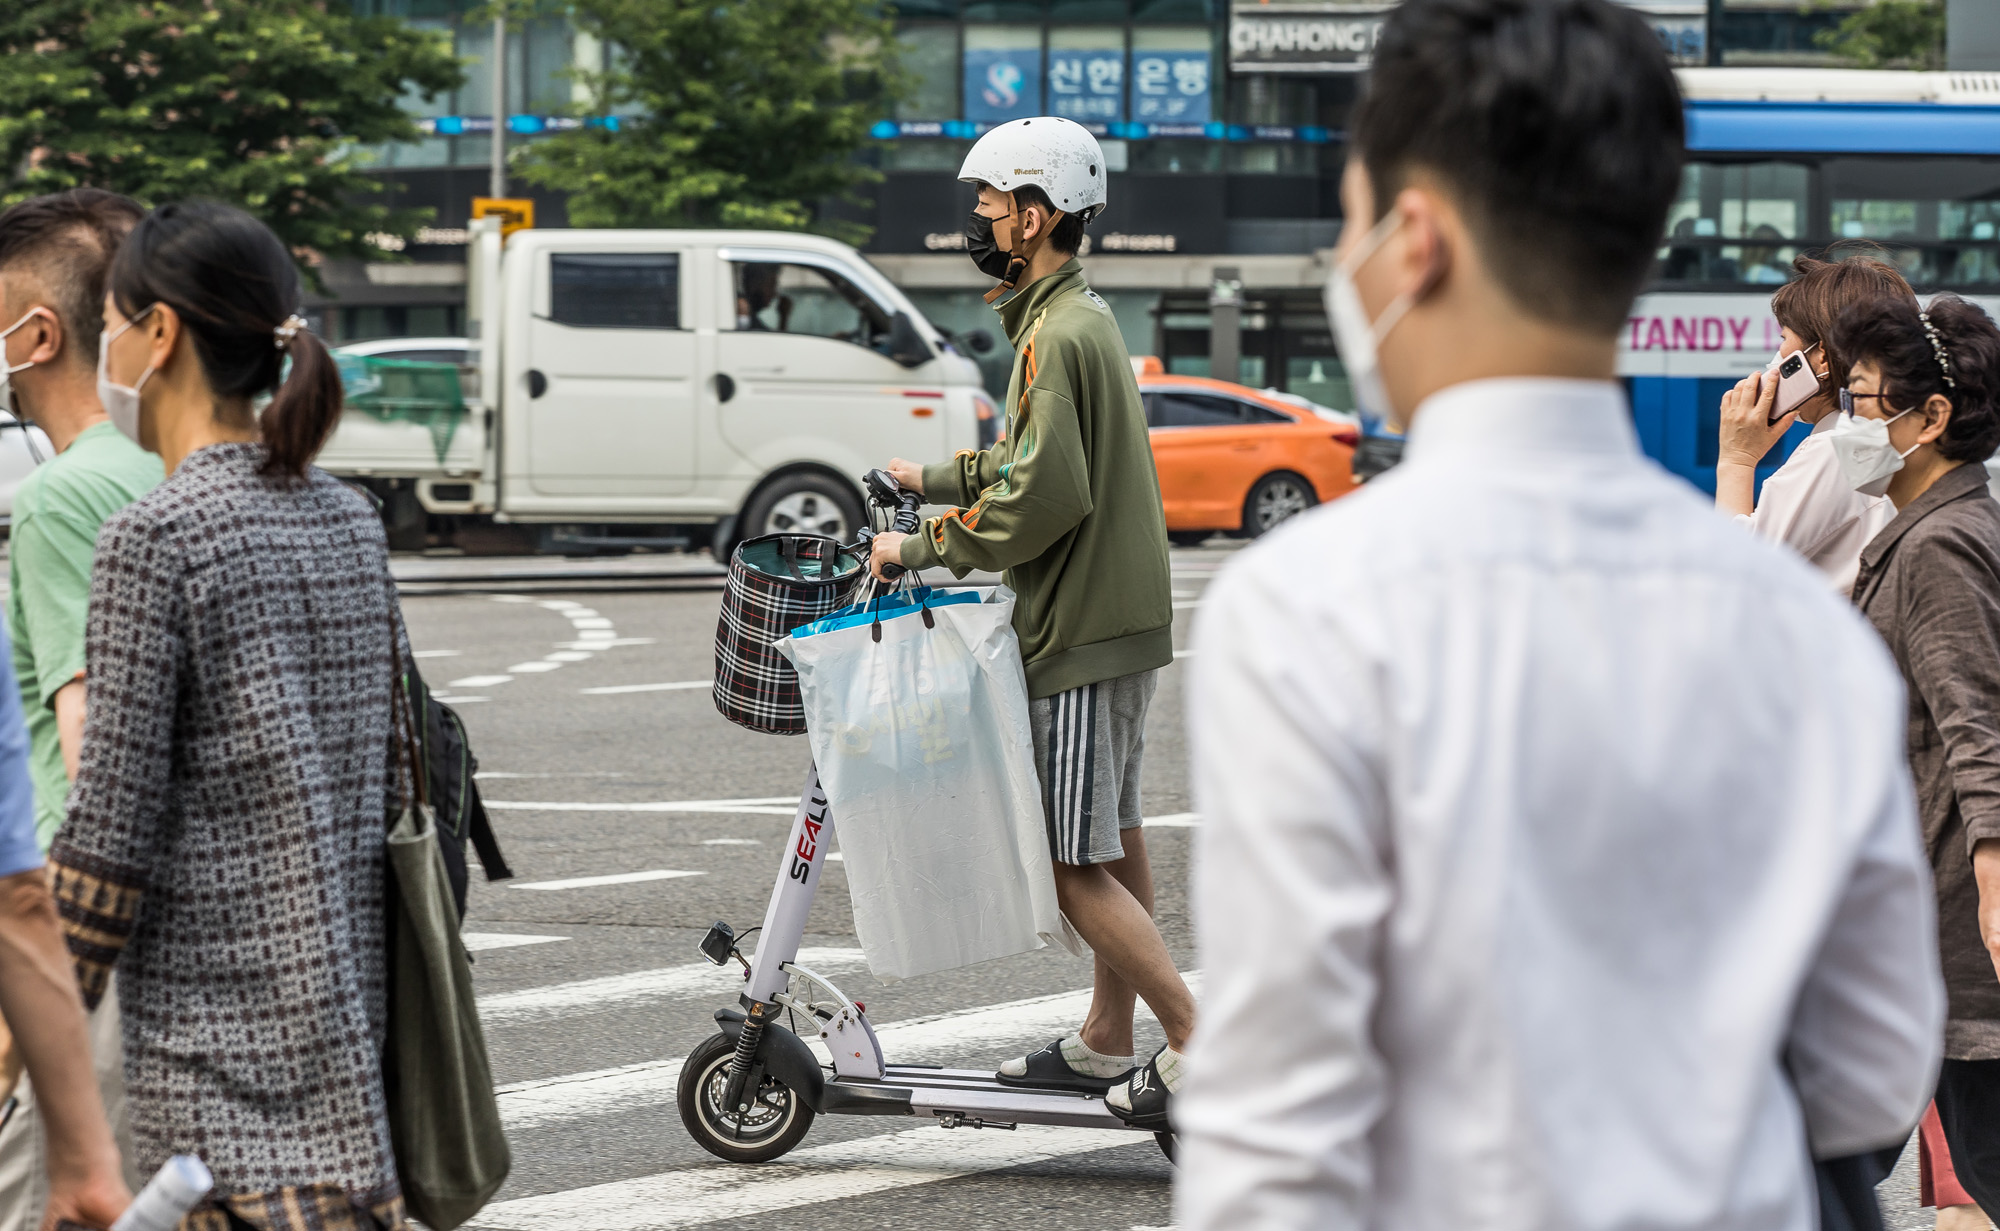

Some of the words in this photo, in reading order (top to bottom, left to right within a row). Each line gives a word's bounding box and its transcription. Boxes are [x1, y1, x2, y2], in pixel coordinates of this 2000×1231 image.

[1231, 22, 1365, 51] CHAHONG
[1051, 57, 1123, 95] 신한
[1138, 57, 1208, 96] 은행
[1629, 316, 1750, 351] TANDY
